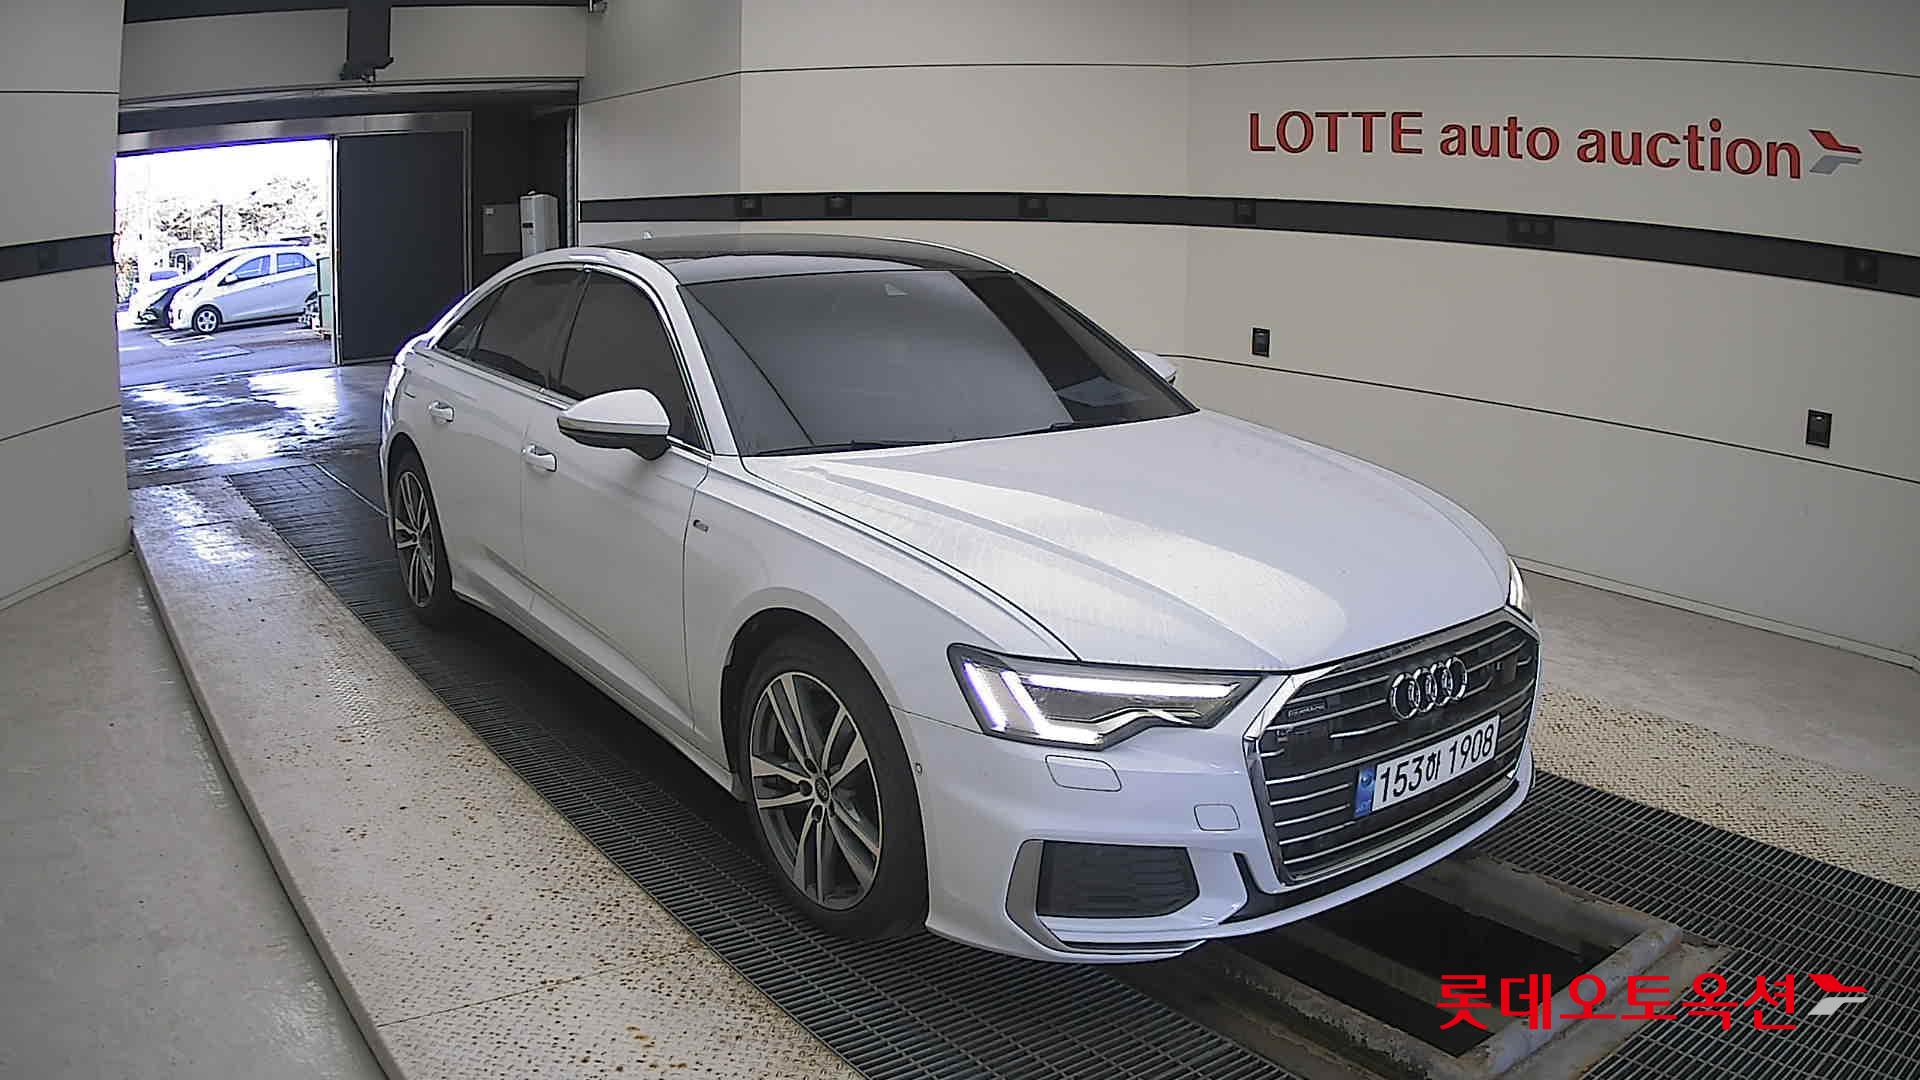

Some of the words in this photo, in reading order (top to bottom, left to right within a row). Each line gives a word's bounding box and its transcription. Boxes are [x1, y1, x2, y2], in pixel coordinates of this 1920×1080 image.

[1248, 110, 1424, 154] LOTTE
[1439, 116, 1560, 160] auto
[1576, 118, 1802, 180] auction
[1380, 751, 1442, 803] 153하
[1449, 724, 1495, 775] 1908
